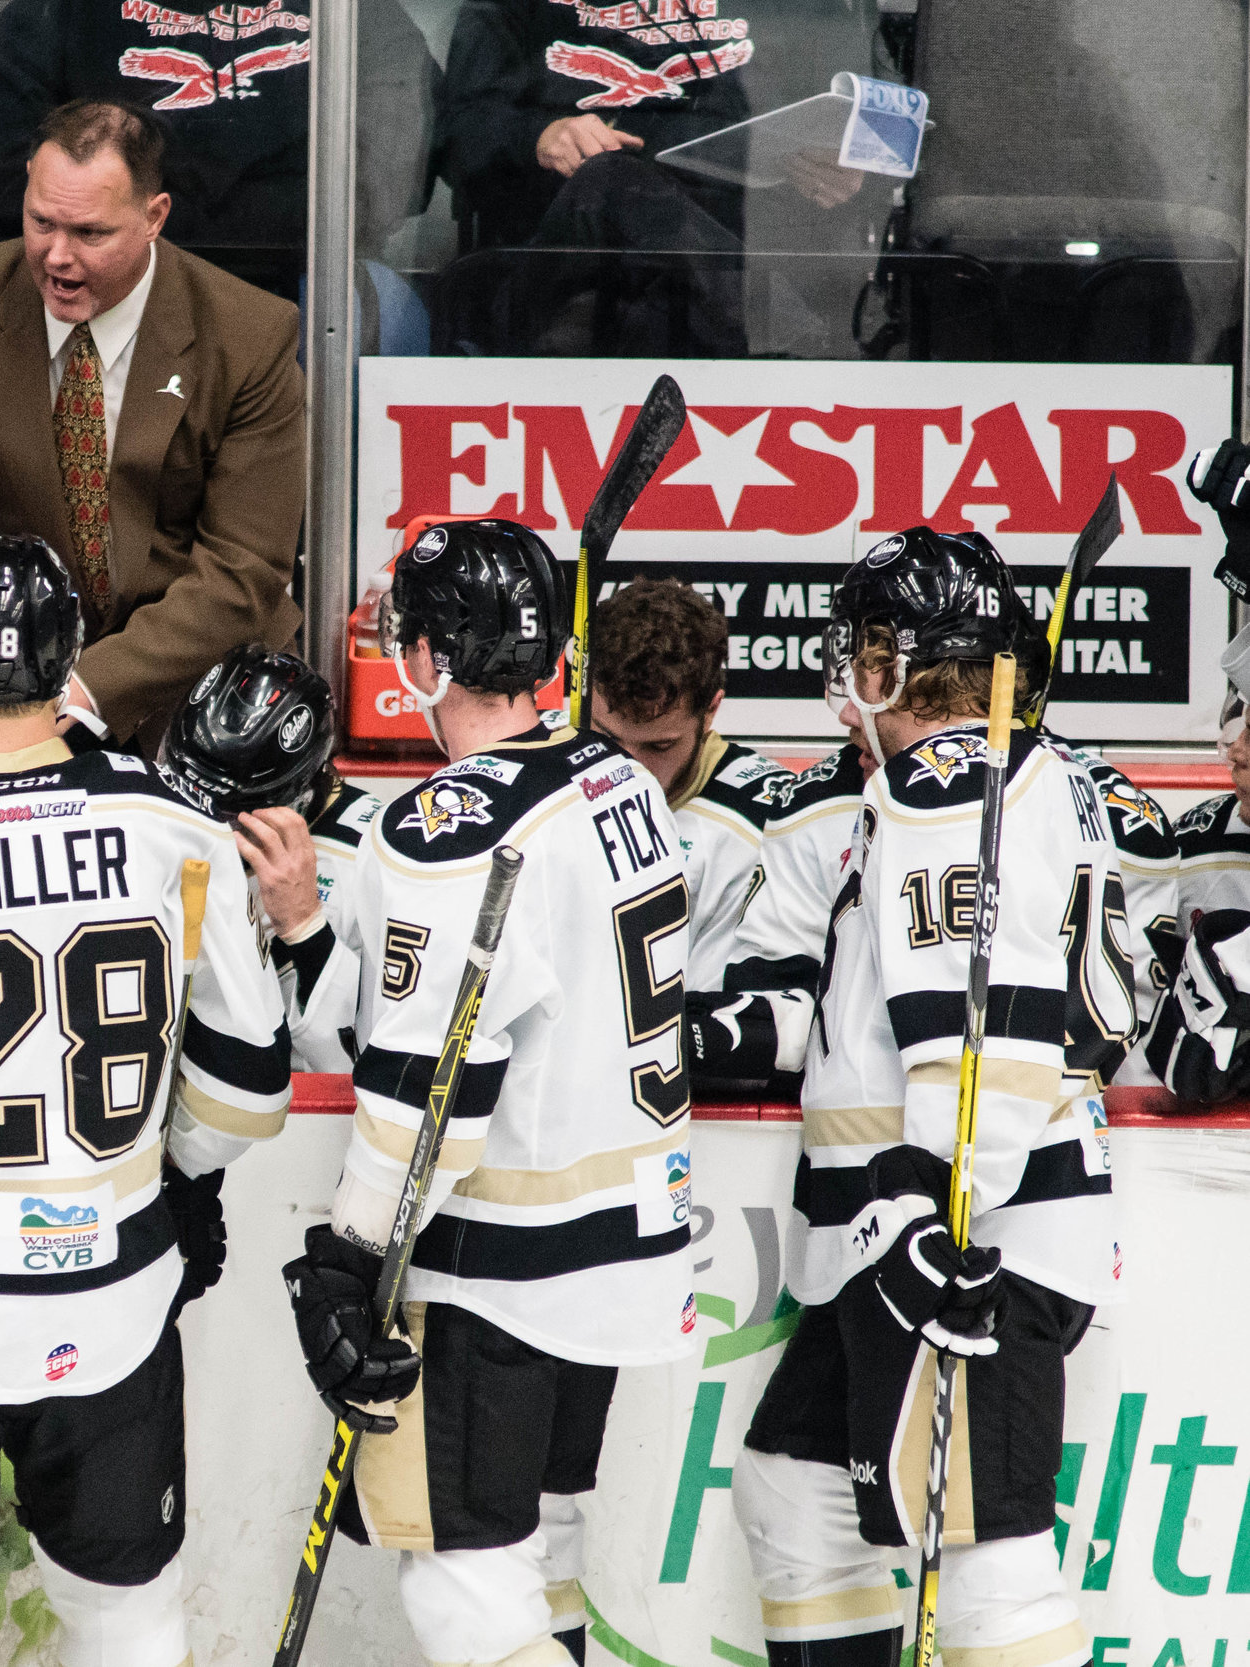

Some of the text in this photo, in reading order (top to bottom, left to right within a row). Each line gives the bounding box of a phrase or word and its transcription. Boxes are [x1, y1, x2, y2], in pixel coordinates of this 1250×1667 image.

[576, 10, 748, 45] THDERBIRDS
[975, 585, 1000, 618] 16
[1014, 585, 1150, 622] ENTER
[520, 607, 538, 639] 5
[437, 763, 503, 779] esBanco
[34, 801, 86, 817] LIGHT
[592, 789, 670, 883] FICK
[980, 883, 997, 959] CCM
[381, 918, 431, 1000] 5
[612, 872, 691, 1129] 5
[460, 997, 482, 1059] CCM
[691, 1023, 704, 1060] CCM
[20, 1232, 99, 1246] Wheeling
[343, 1225, 387, 1255] Reebo
[23, 1247, 93, 1270] CVB
[45, 1350, 80, 1378] ECHL
[303, 1417, 354, 1575] CCM
